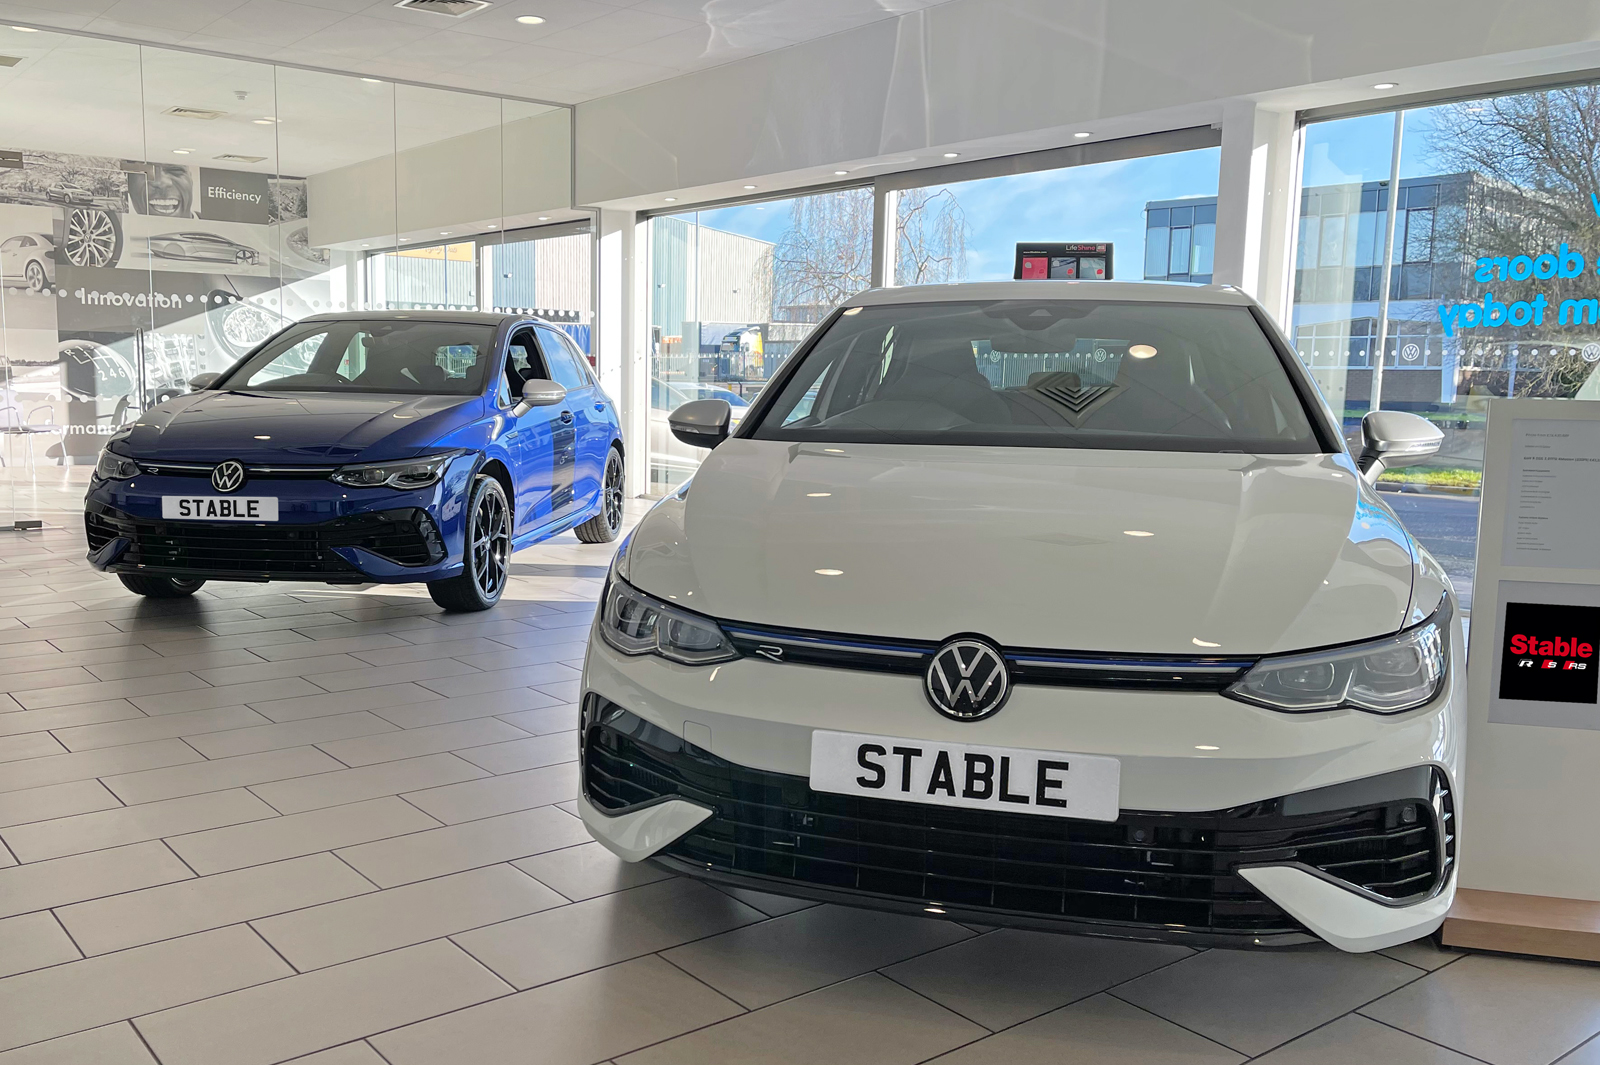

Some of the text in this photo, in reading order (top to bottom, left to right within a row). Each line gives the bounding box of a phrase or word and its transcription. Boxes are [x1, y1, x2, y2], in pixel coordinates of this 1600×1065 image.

[208, 186, 262, 204] Efficiency
[80, 287, 182, 309] Innovation
[179, 499, 260, 518] STABLE
[1509, 633, 1593, 658] Stable
[1517, 659, 1534, 668] R
[855, 743, 1070, 809] STABLE
